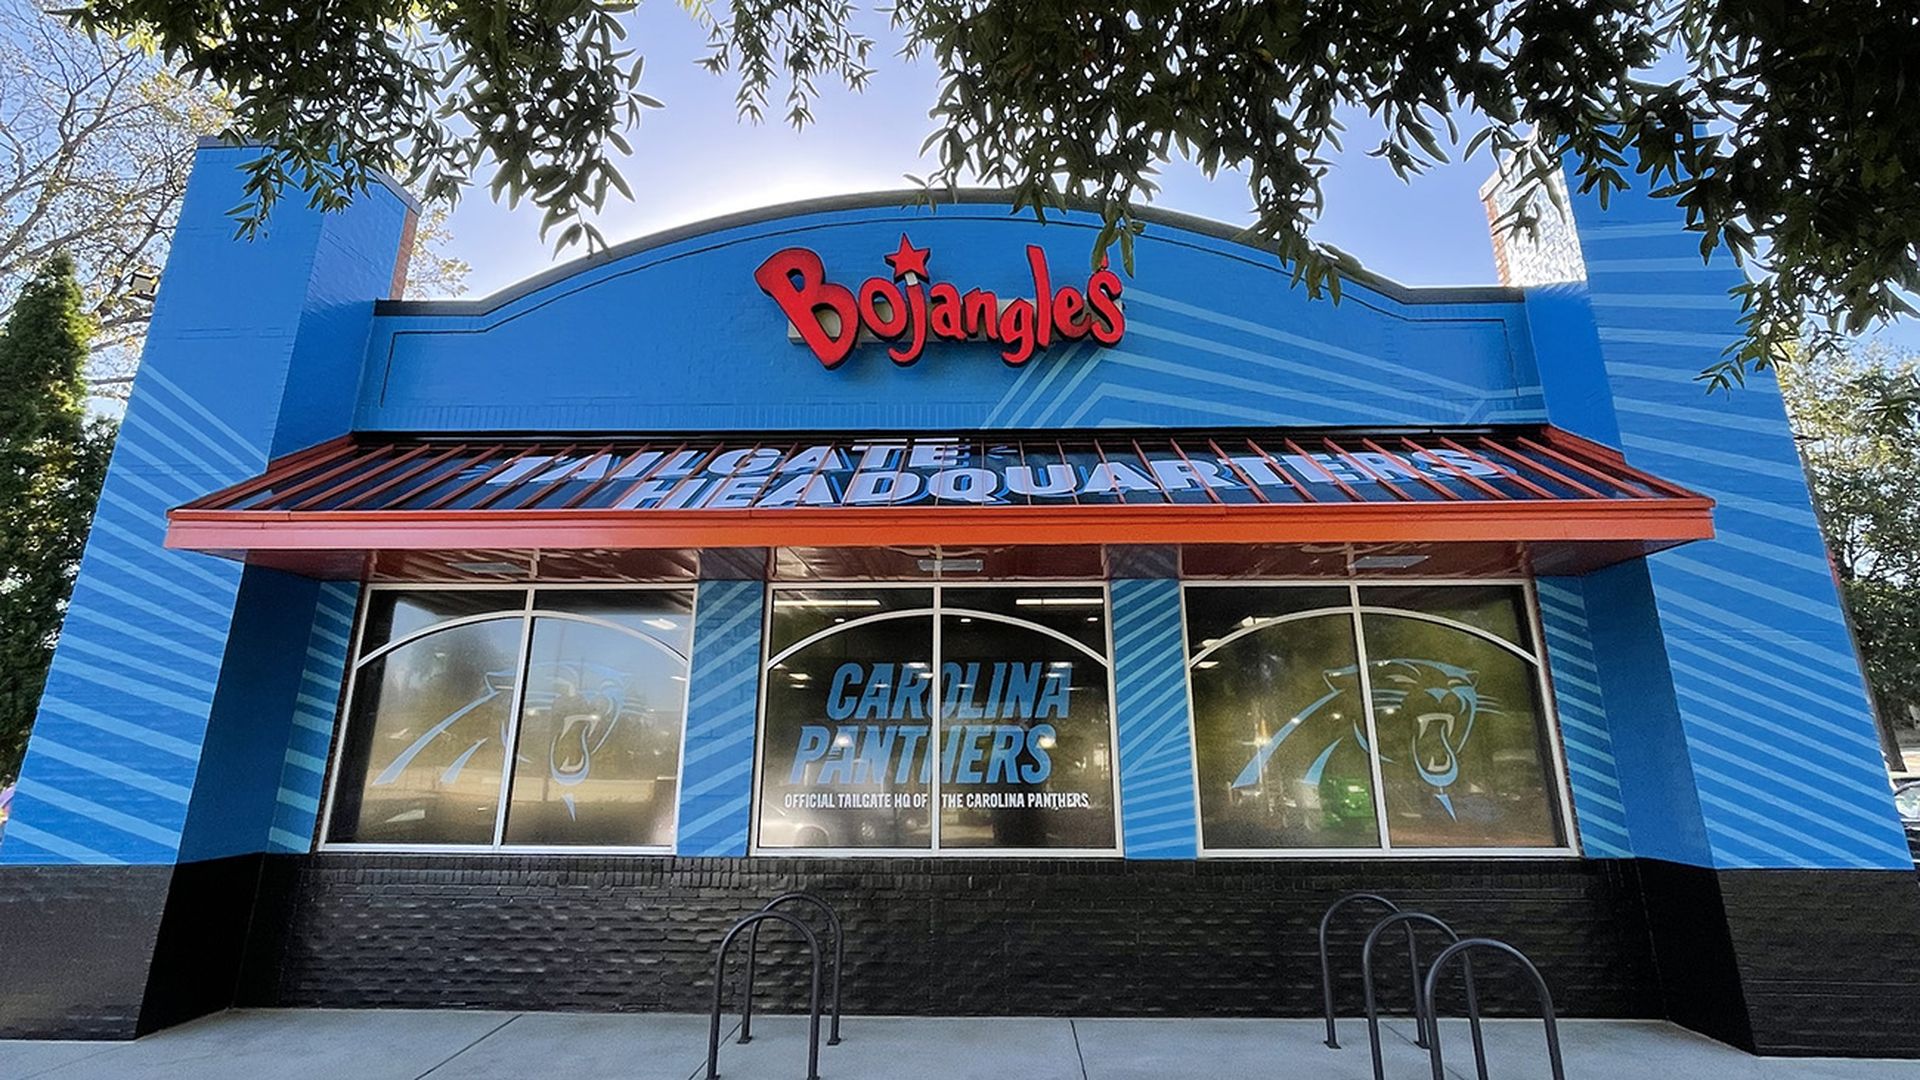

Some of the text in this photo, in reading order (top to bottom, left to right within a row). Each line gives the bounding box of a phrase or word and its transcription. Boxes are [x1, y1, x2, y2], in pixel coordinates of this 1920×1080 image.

[486, 438, 968, 485] TAILGATE
[612, 449, 1506, 509] HEADQUARTERS
[826, 662, 1073, 720] CAROLINA
[788, 724, 1057, 784] PANTHERS
[784, 793, 1089, 809] OFFICIAL TAILGATE HQ OF THE CAROLINA PANTHERS
